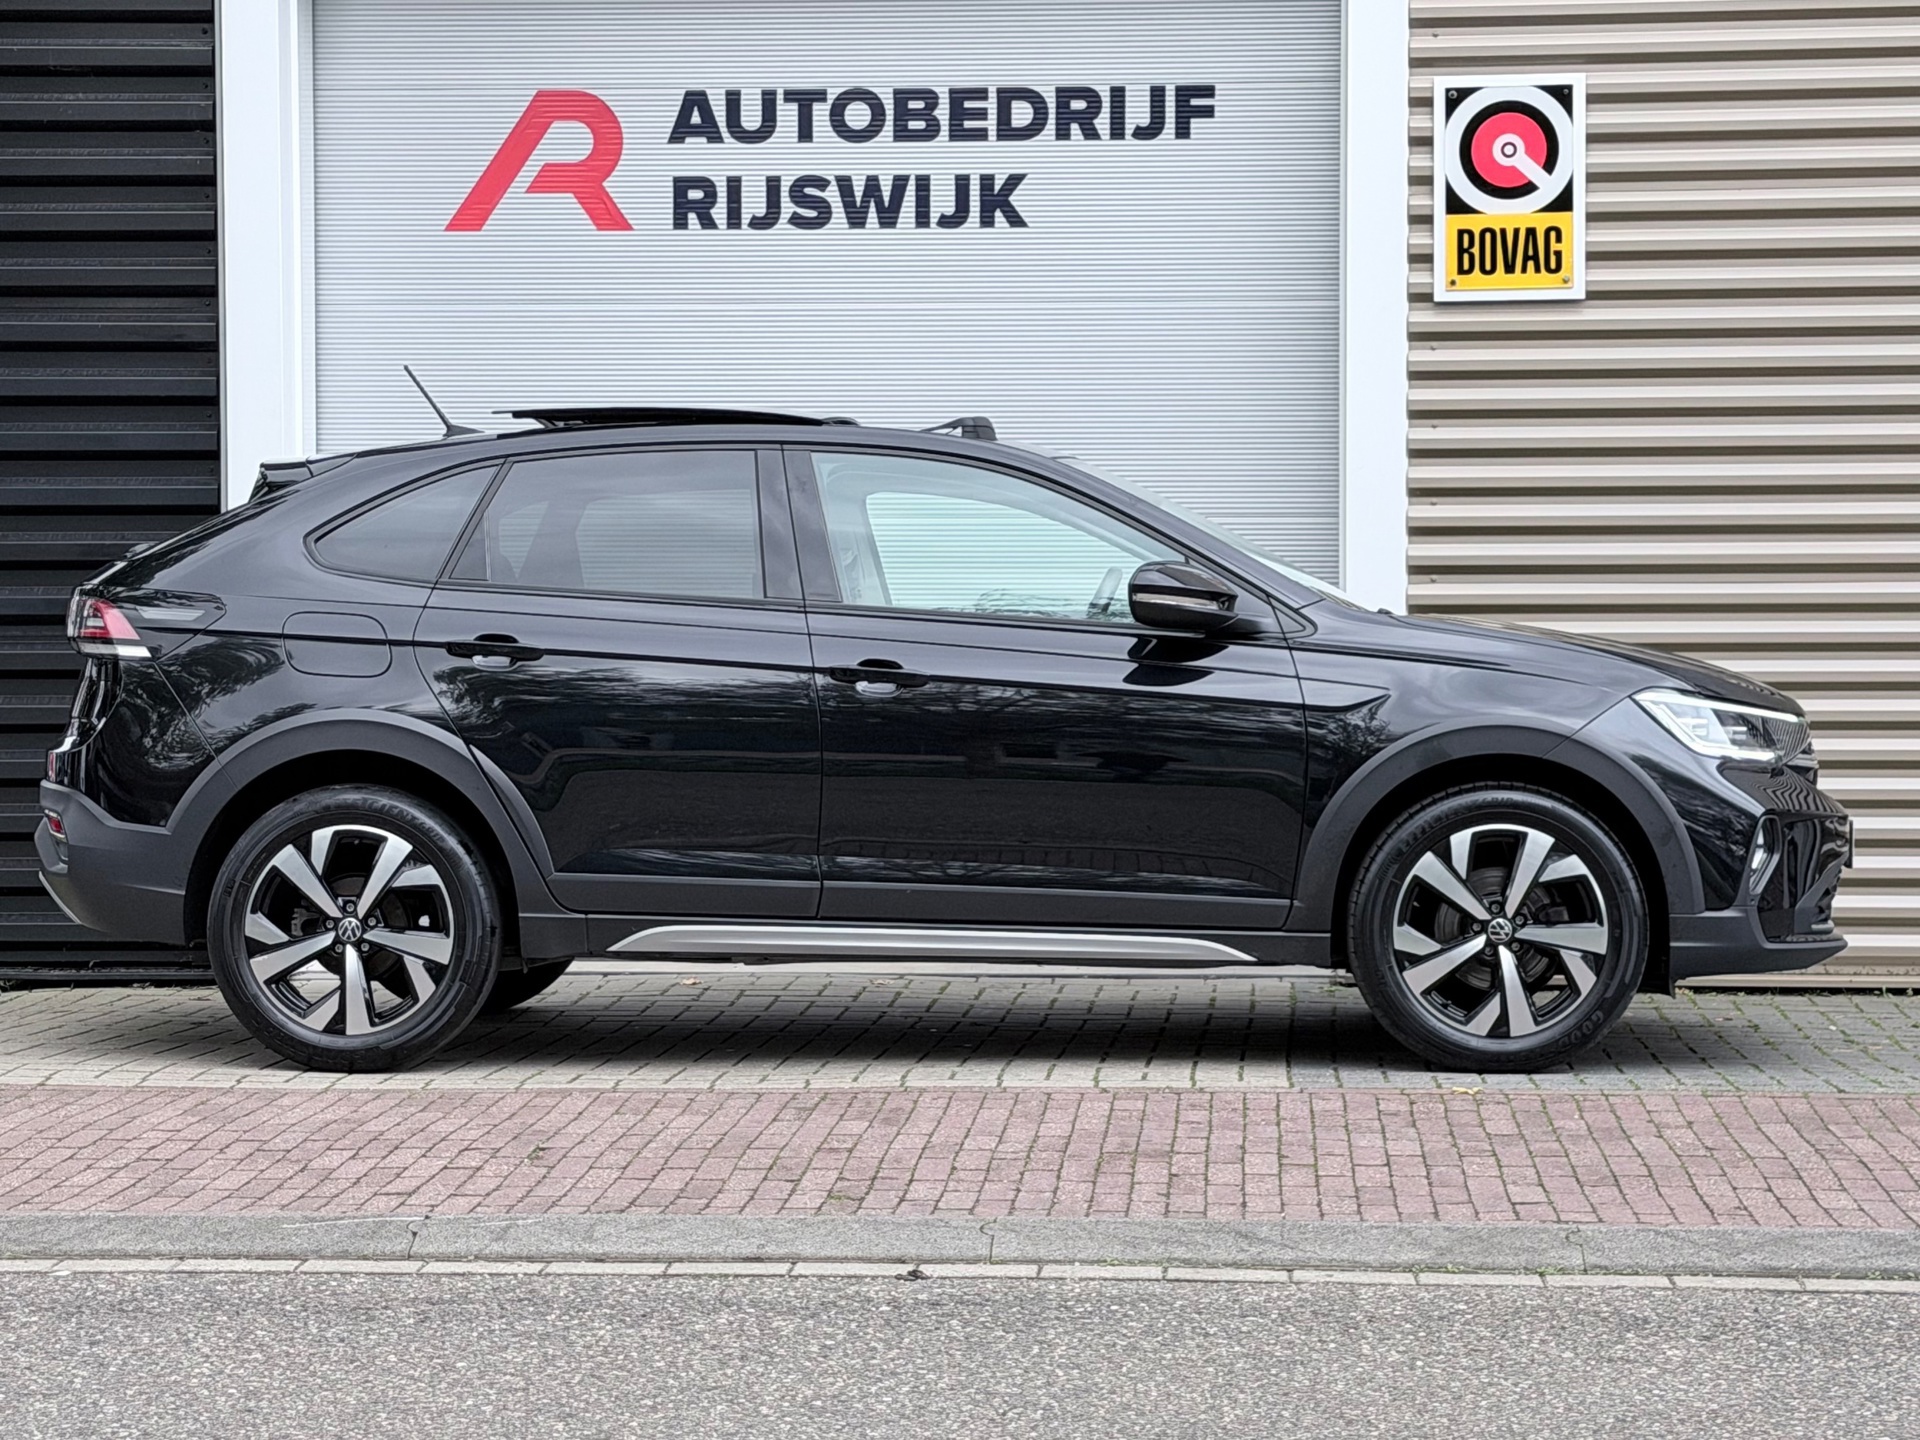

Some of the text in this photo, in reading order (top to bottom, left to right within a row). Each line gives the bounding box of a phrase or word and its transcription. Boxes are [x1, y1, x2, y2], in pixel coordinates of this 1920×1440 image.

[667, 84, 1216, 145] AUTOBEDRIJF
[671, 174, 1028, 231] RIJSWIJK
[1456, 225, 1563, 276] BOVAG
